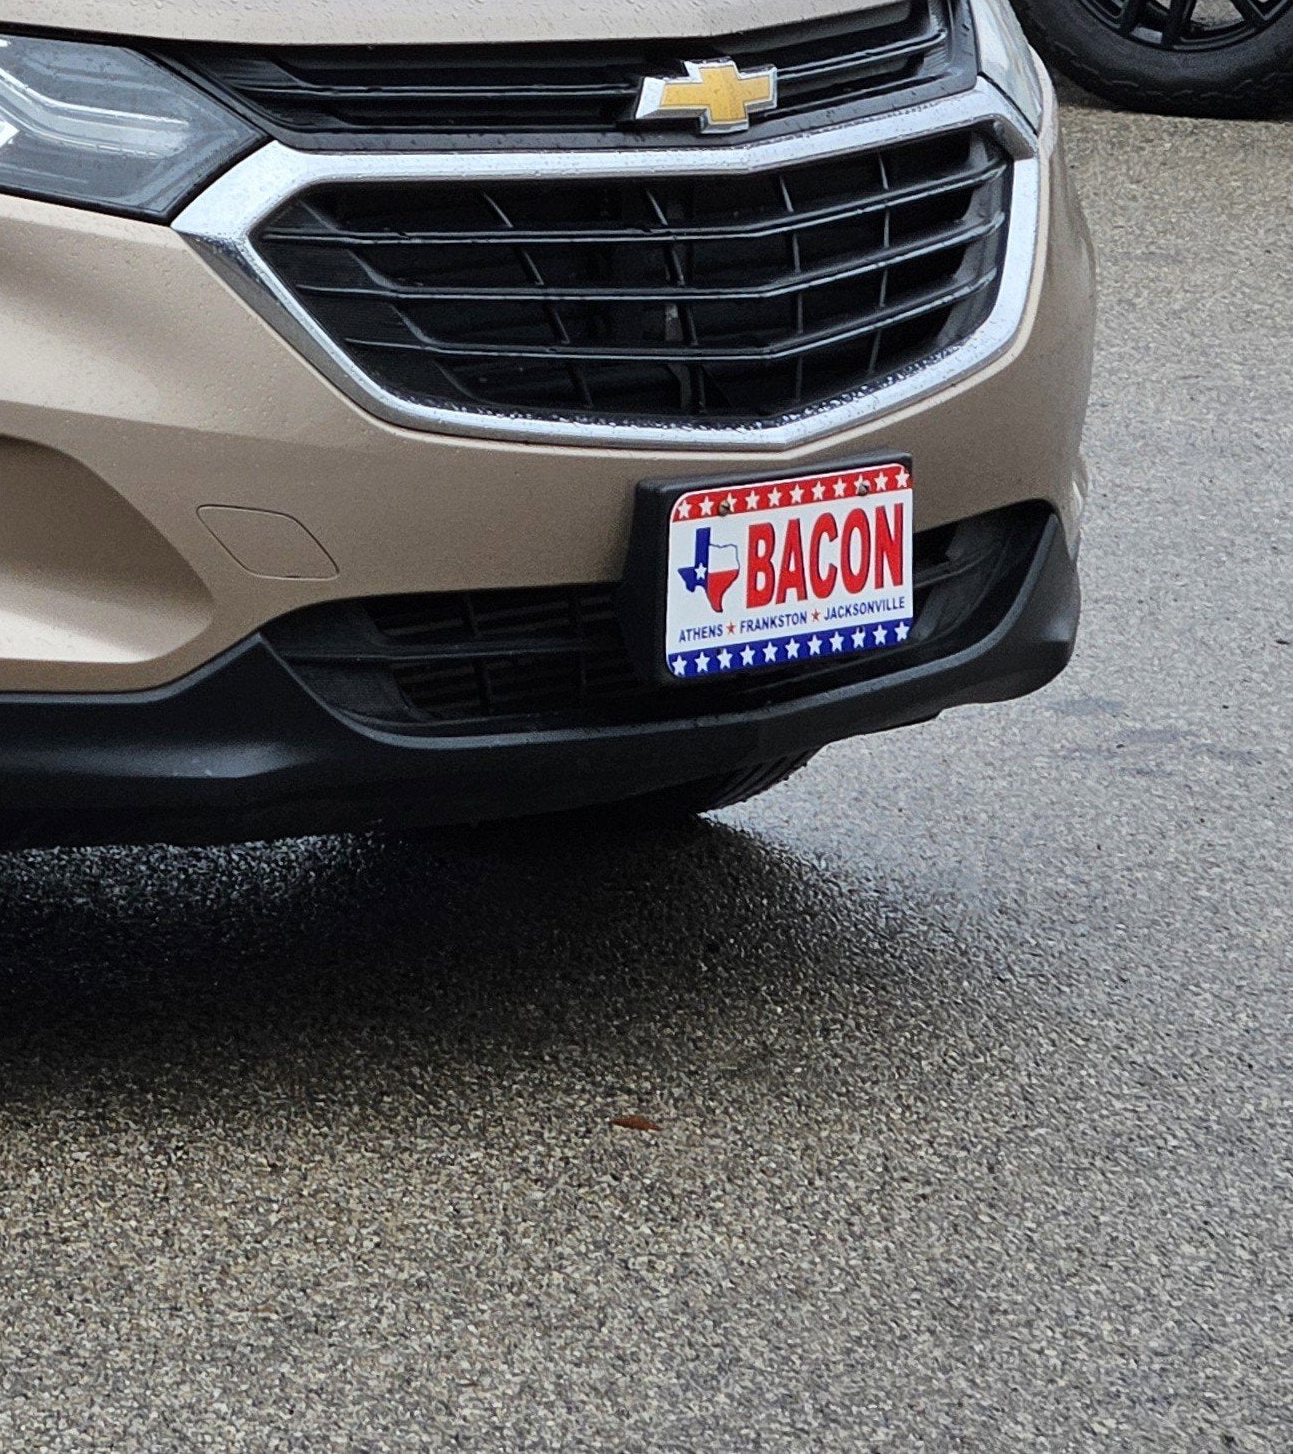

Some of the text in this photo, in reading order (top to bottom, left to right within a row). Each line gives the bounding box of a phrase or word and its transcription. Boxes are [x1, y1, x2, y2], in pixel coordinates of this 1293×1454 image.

[746, 501, 905, 609] BACON
[679, 596, 905, 643] ATHENS FRANKSTON JACKSONVILLE
